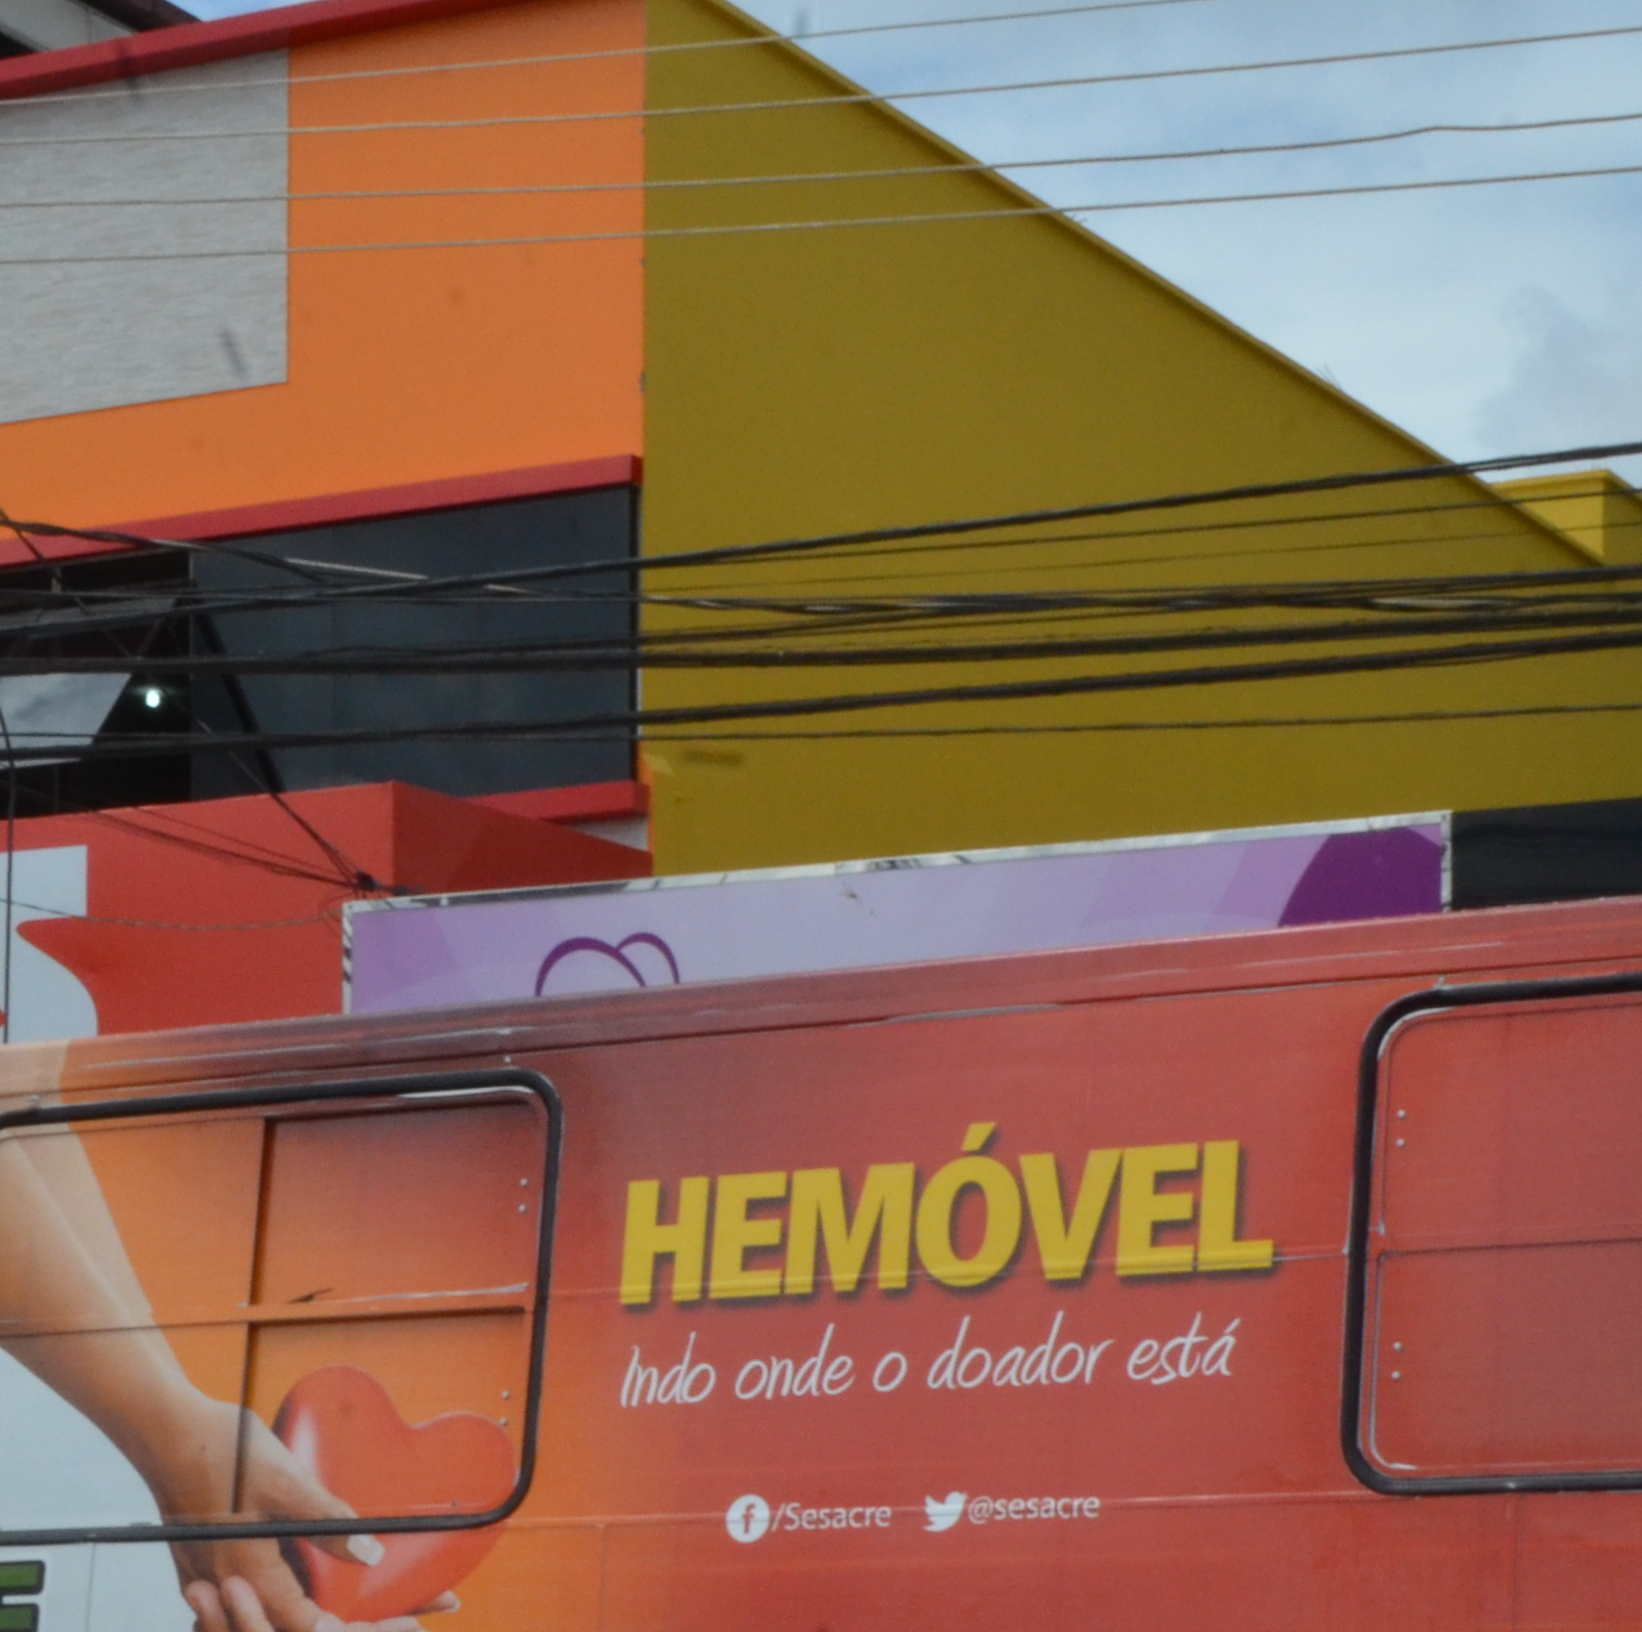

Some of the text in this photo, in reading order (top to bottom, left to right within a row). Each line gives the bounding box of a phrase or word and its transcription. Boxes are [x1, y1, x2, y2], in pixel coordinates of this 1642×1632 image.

[619, 1121, 1275, 1306] HEMÓVEL
[619, 1311, 1241, 1408] Indo onde o doador está
[771, 1494, 1100, 1532] /Sesacre @sesacre
